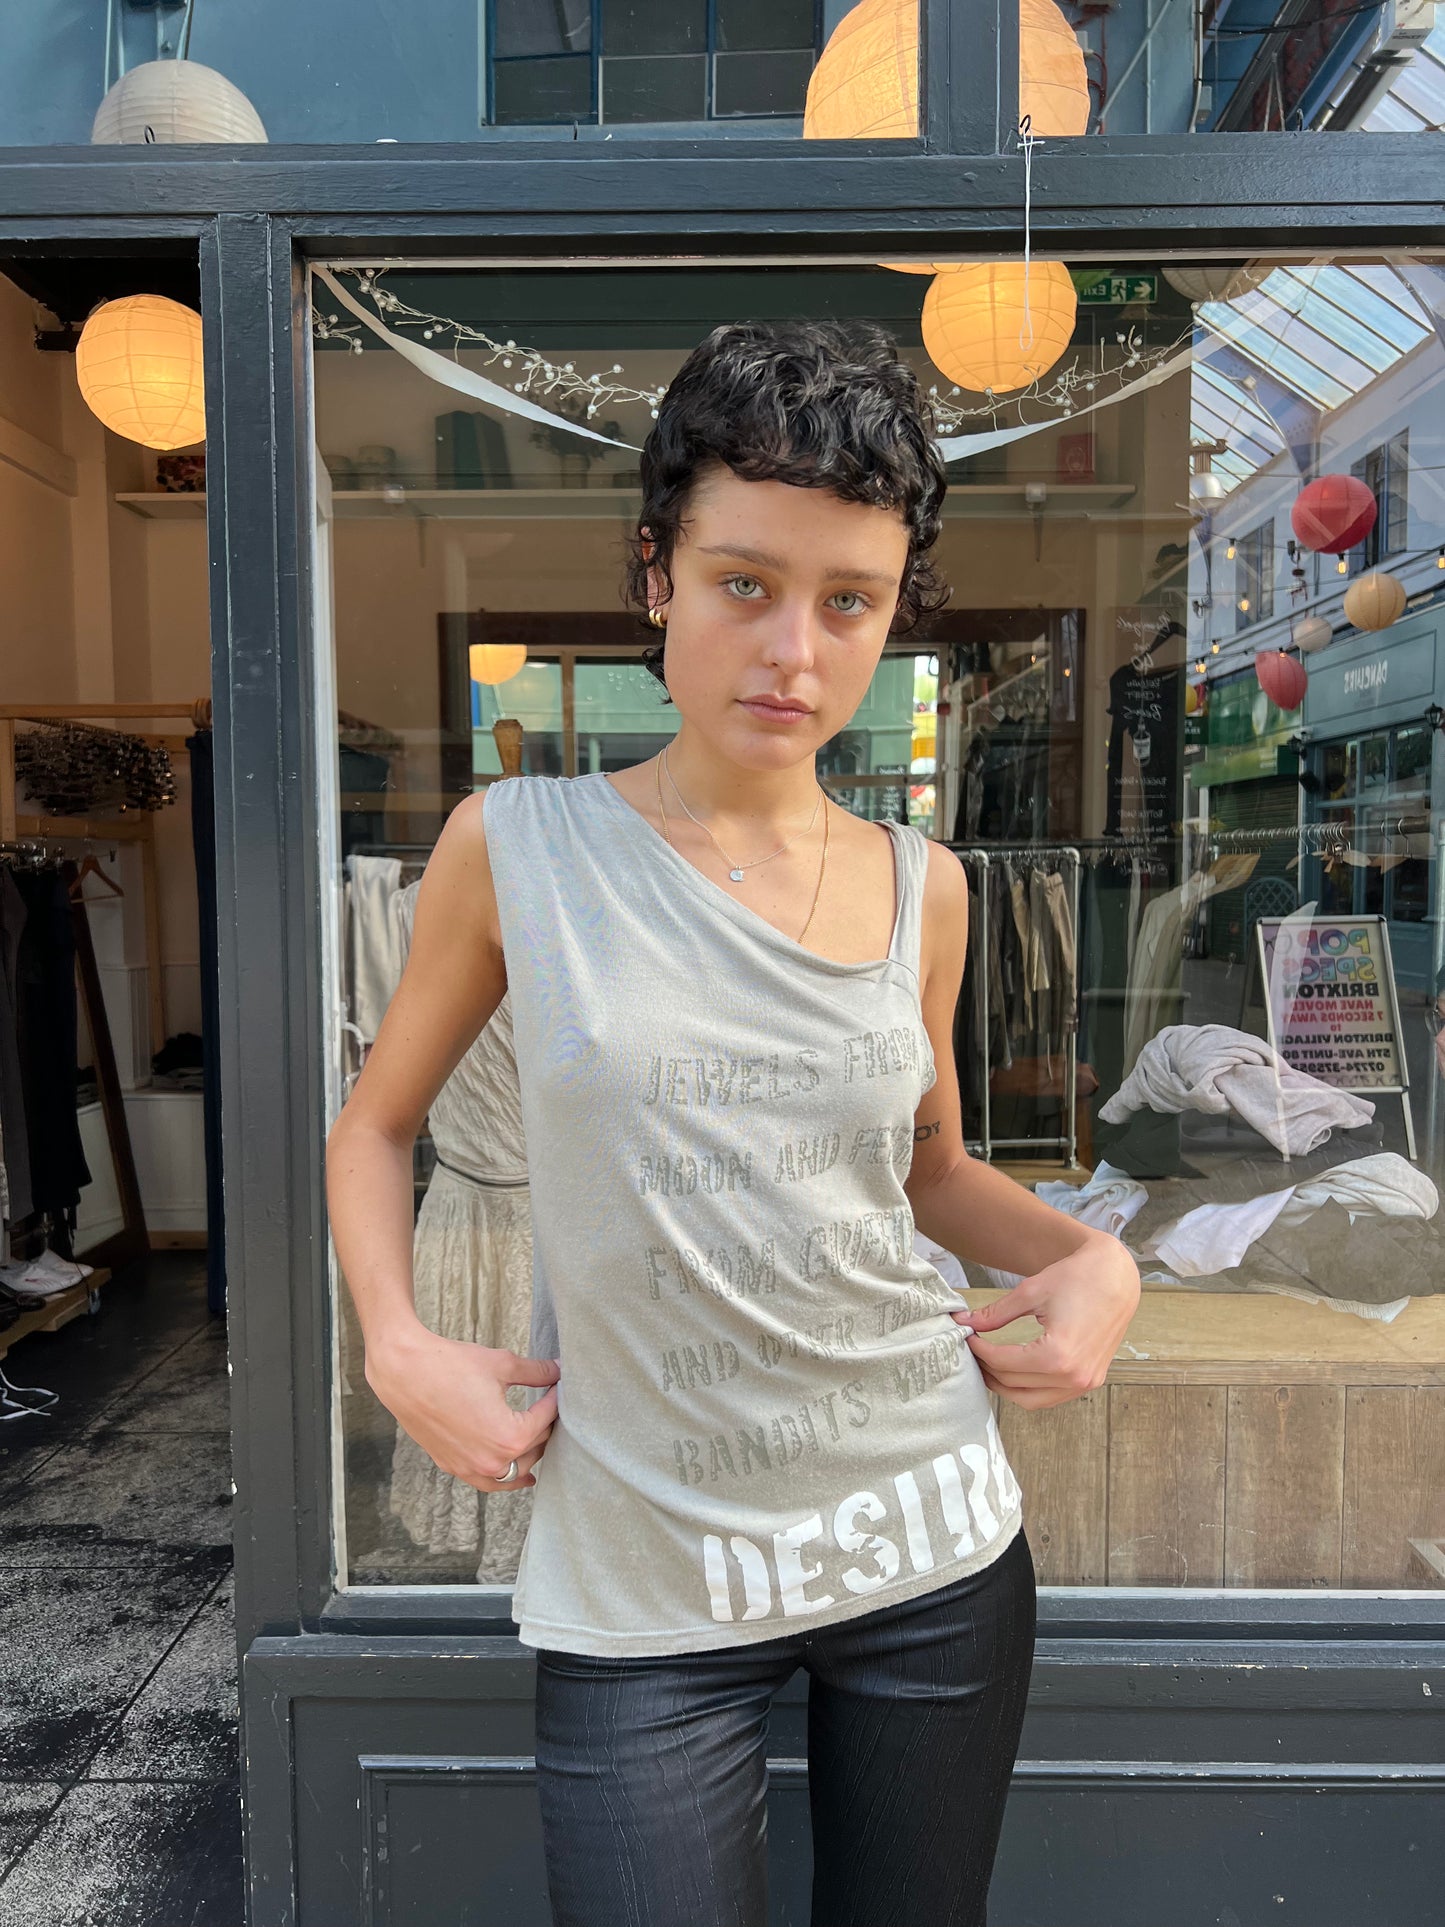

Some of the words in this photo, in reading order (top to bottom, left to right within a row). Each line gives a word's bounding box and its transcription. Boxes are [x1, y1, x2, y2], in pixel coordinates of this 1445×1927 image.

[642, 1048, 820, 1106] JEWELS
[774, 1131, 841, 1184] AND
[661, 1340, 740, 1392] AND
[672, 1380, 872, 1486] BANDITS
